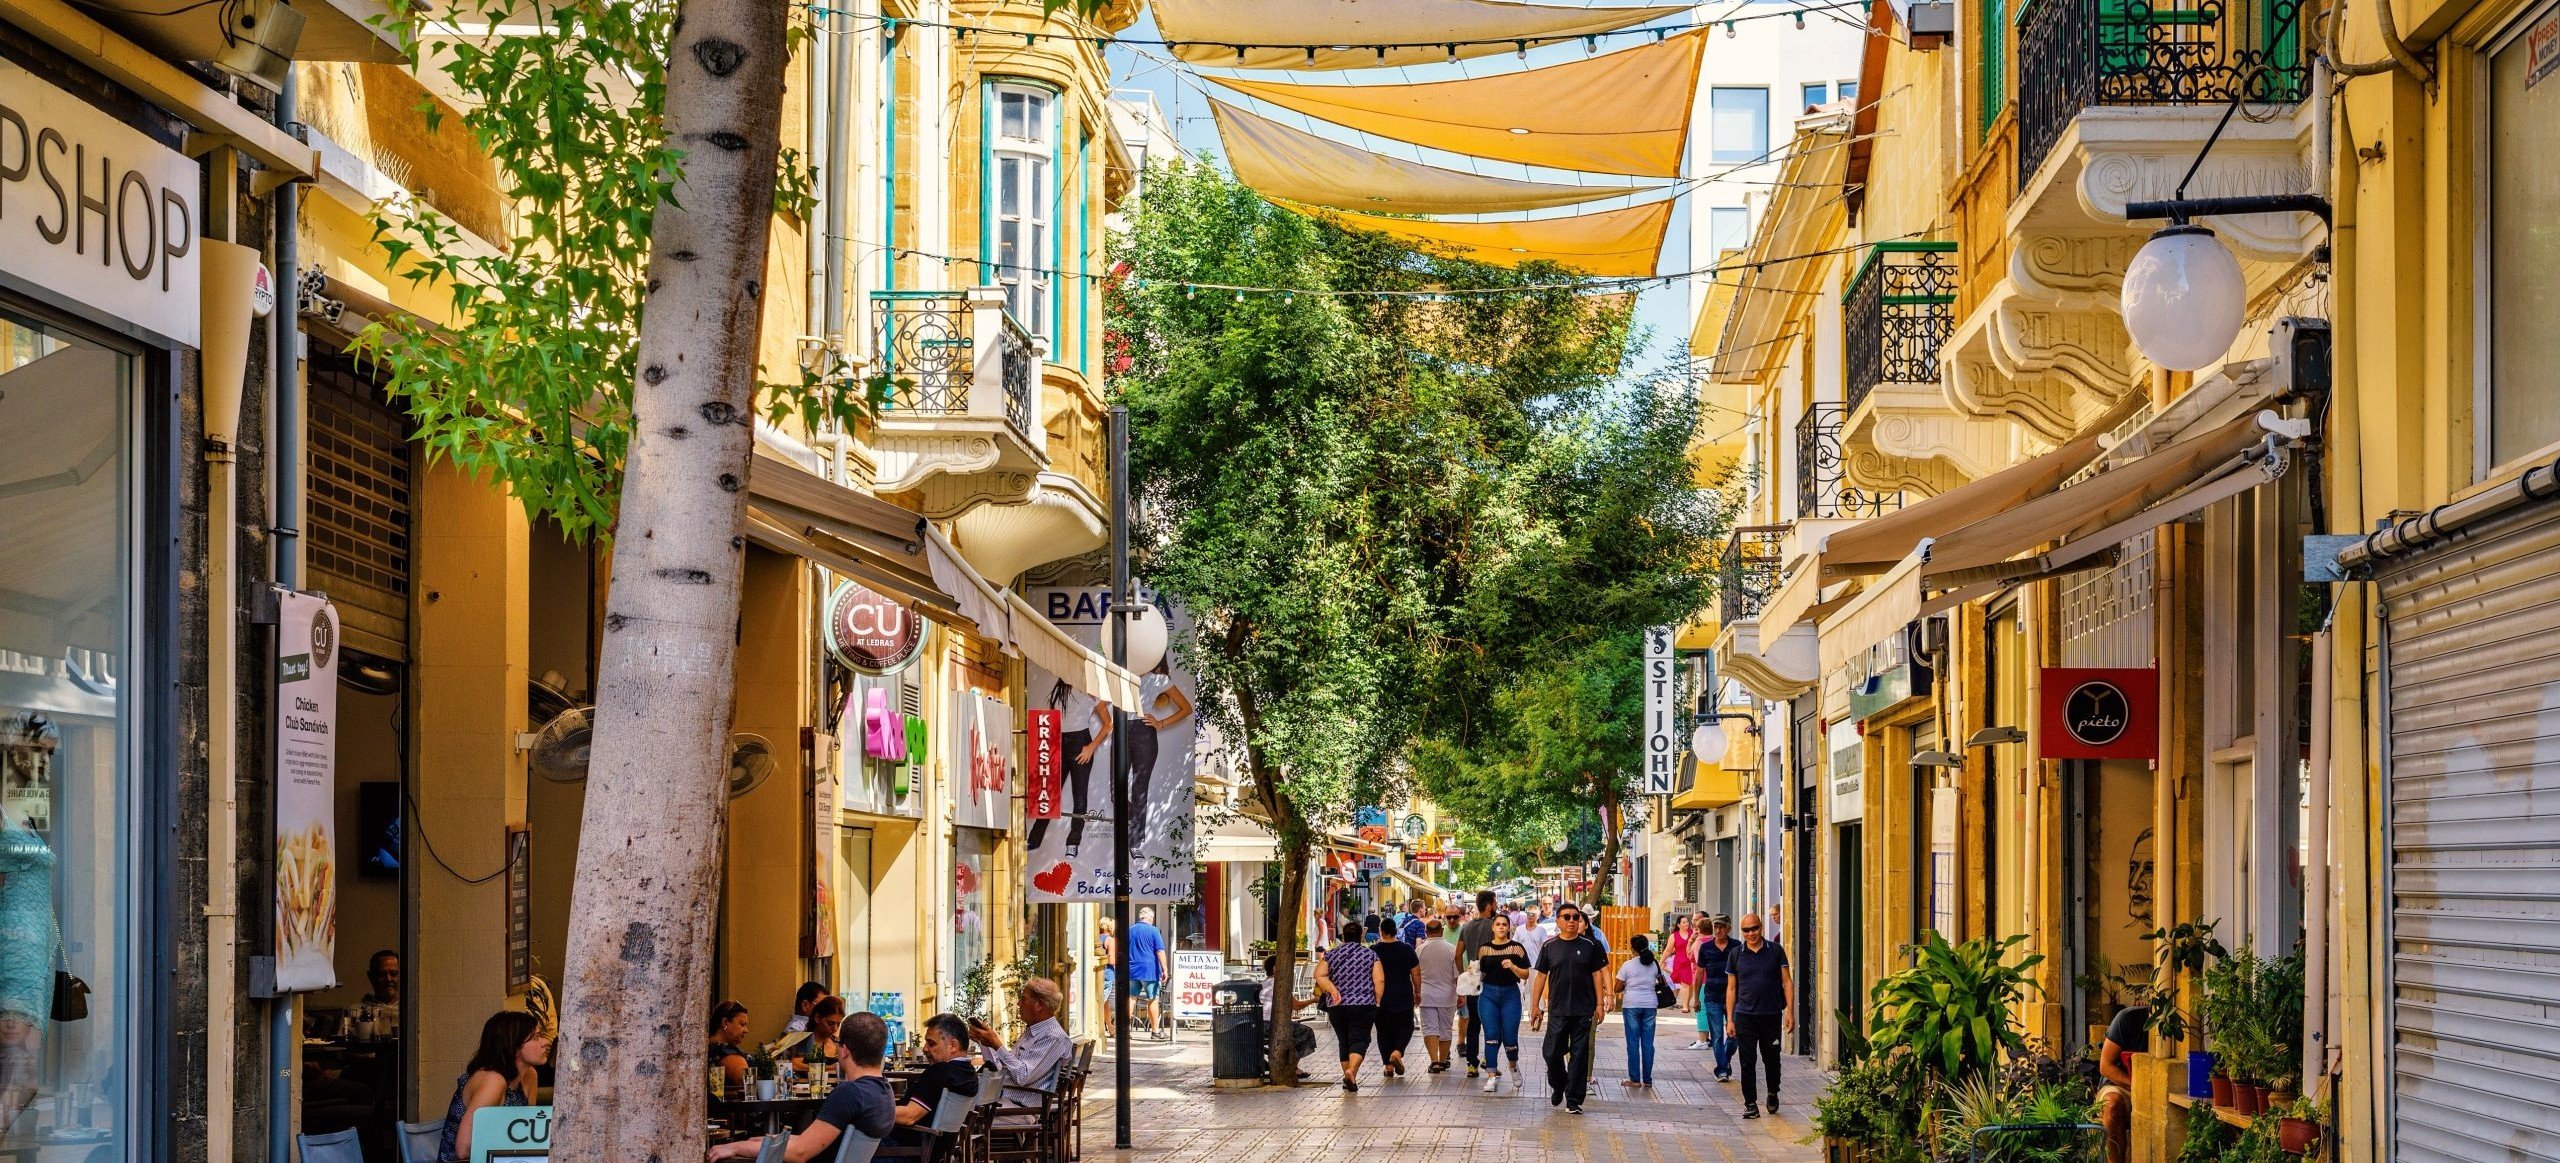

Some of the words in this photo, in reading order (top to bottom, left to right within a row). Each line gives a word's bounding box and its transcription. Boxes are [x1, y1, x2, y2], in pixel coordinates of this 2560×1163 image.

[0, 104, 190, 292] PSHOP
[866, 639, 895, 647] LEDRAS
[837, 637, 861, 663] MEETING
[869, 657, 898, 668] COFFEE
[897, 641, 916, 660] PLACE
[295, 696, 319, 713] Chicken
[285, 715, 299, 731] Club
[299, 717, 329, 735] Sandwich
[2077, 714, 2120, 733] pieto
[1038, 714, 1051, 815] KRASHIAS
[1094, 868, 1115, 879] Bac
[1137, 869, 1169, 880] School
[1077, 881, 1112, 895] Back
[1688, 867, 1697, 902] bamboo
[1189, 972, 1206, 980] ALL
[1183, 981, 1213, 990] SILVER
